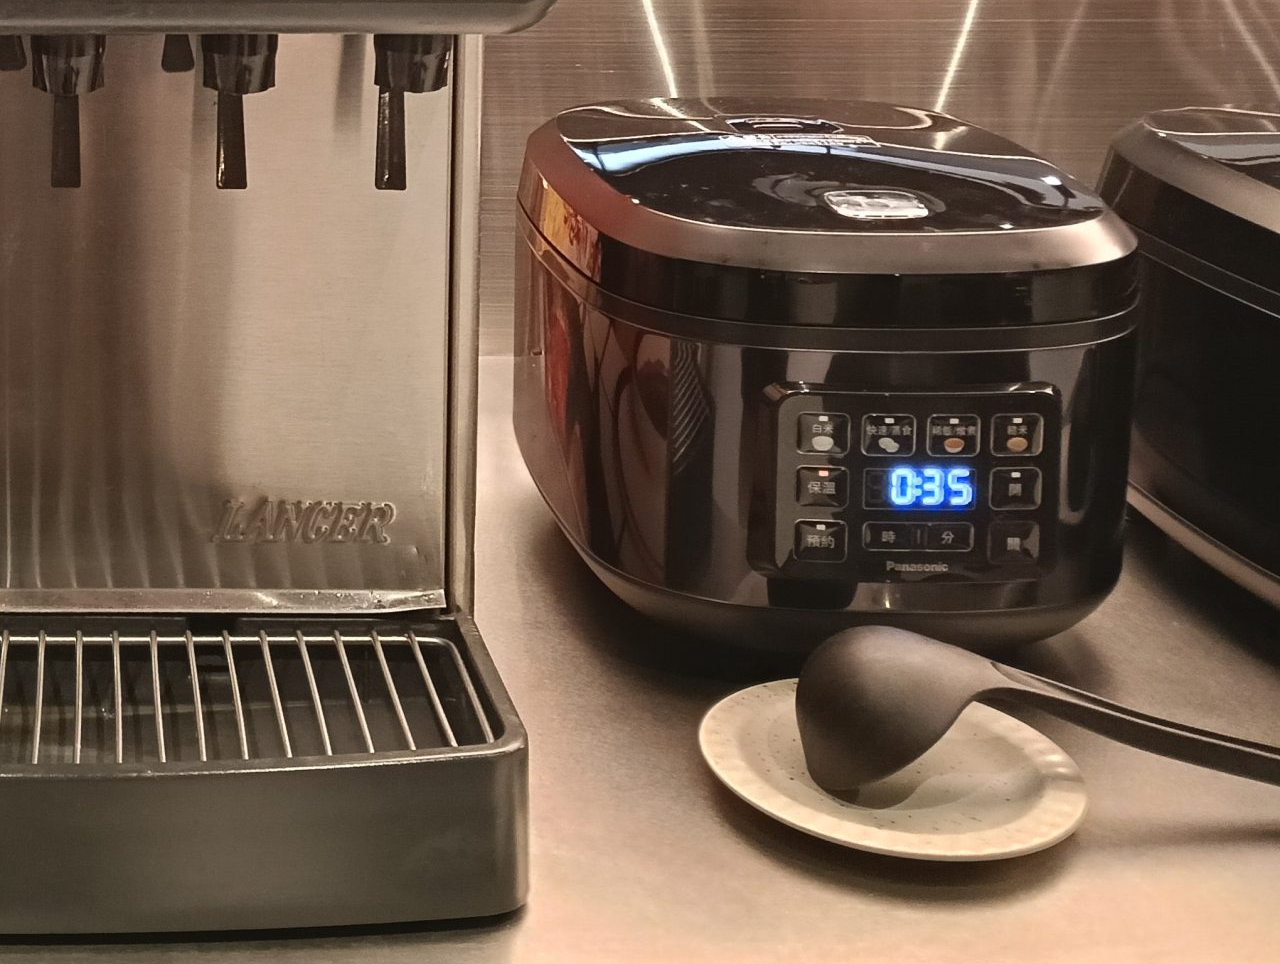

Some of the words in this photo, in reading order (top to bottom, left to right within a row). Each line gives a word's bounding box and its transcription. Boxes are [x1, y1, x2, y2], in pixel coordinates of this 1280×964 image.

[890, 467, 973, 506] 0:35
[212, 497, 397, 545] LANCER
[941, 530, 955, 544] 分
[886, 560, 949, 572] Panasonic
